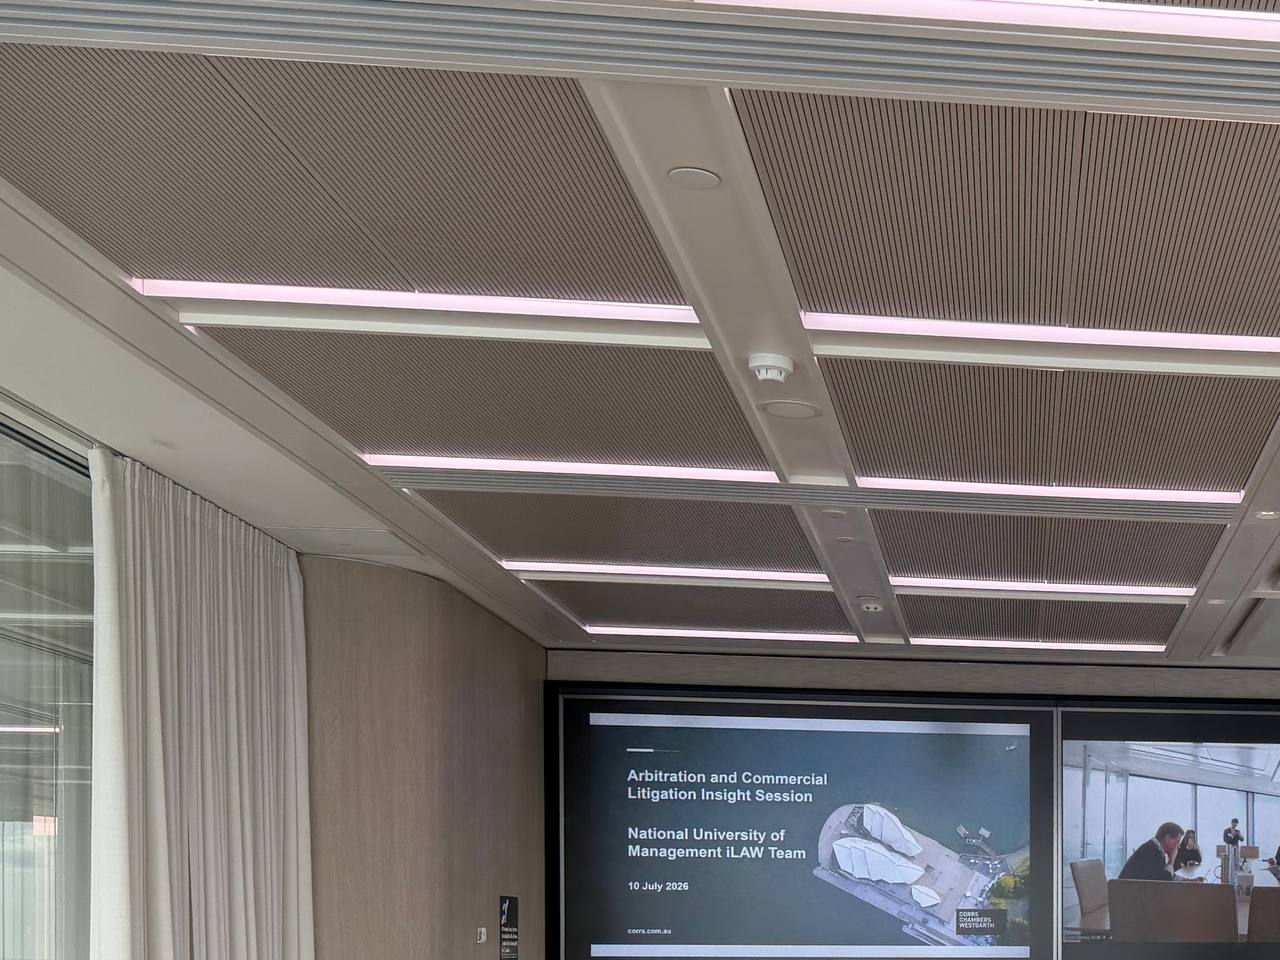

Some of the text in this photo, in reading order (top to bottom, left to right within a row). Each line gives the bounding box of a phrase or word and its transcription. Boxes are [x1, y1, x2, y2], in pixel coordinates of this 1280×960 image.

[627, 769, 829, 786] Arbitration and Commercial
[627, 786, 813, 804] Litigation Insight Session
[628, 826, 787, 844] National University of
[628, 844, 807, 860] Management iLAW Team
[628, 881, 690, 893] 10 July 2026
[627, 927, 673, 935] corrs.com.au
